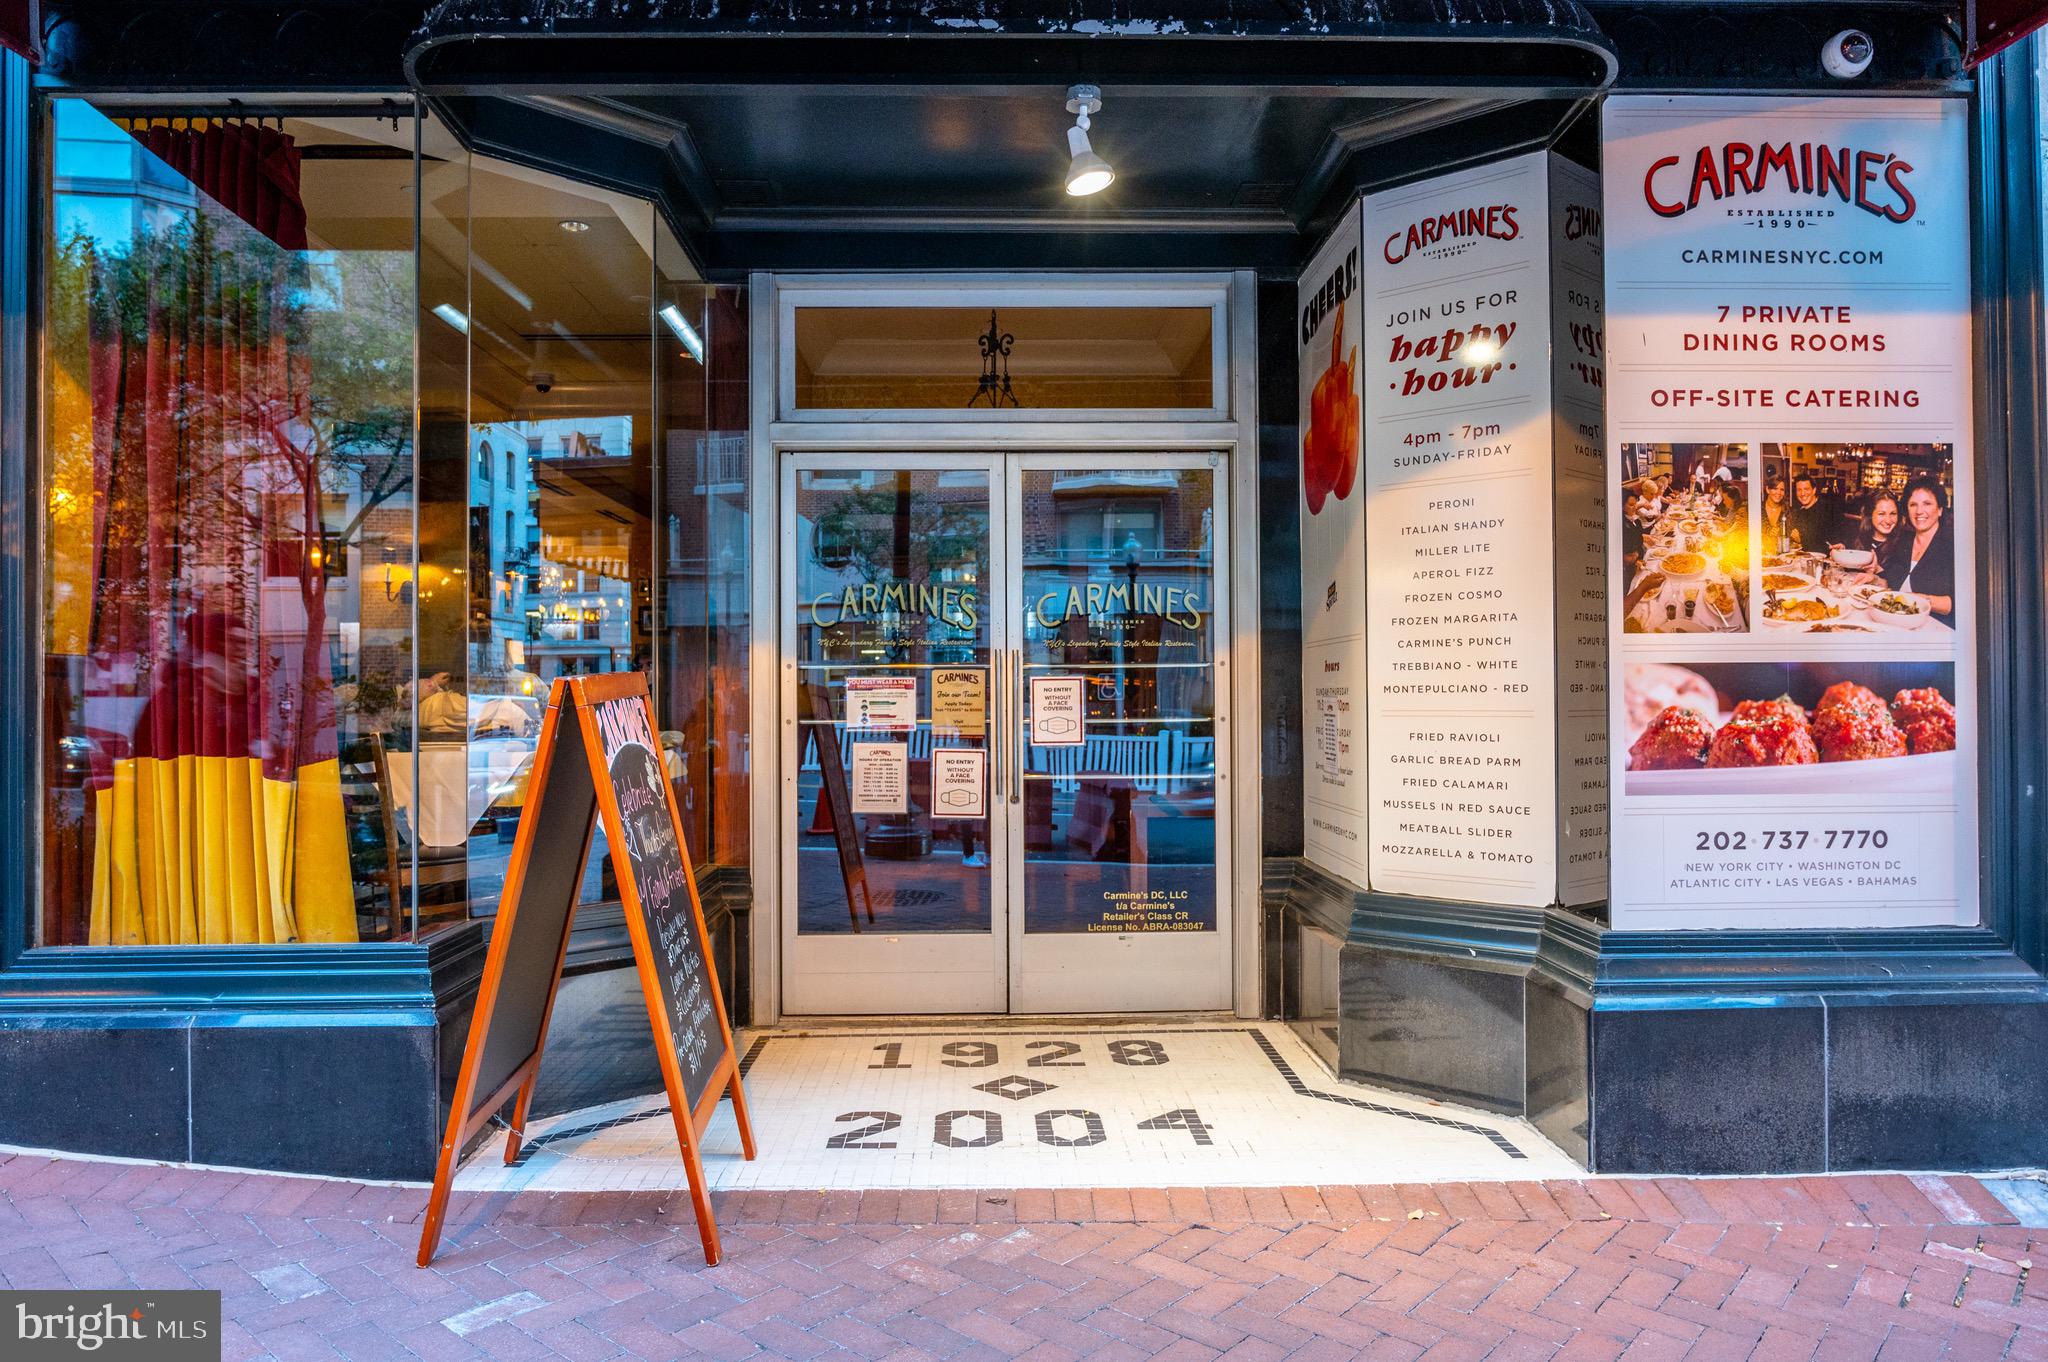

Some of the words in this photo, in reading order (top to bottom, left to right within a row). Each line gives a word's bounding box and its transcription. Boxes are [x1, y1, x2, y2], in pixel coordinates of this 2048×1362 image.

[1644, 142, 1916, 224] CARMINE'S
[1727, 210, 1835, 218] ESTABLISHED
[1384, 204, 1520, 264] CARMINE'S
[1682, 250, 1883, 265] CARMINESNYC.COM
[1302, 246, 1357, 345] CHEERS!
[1386, 307, 1431, 328] JOIN
[1441, 300, 1465, 316] US
[1476, 290, 1517, 310] FOR
[1718, 306, 1730, 323] 7
[1742, 306, 1851, 323] PRIVATE
[1684, 334, 1778, 351] DINING
[1791, 334, 1886, 352] ROOMS
[1650, 389, 1774, 408] OFF-SITE
[1786, 388, 1920, 408] CATERING
[1404, 432, 1440, 447] 4pm
[1462, 424, 1500, 439] 7pm
[1394, 444, 1512, 468] SUNDAY-FRIDAY
[1429, 498, 1474, 510] PERONI
[1402, 523, 1449, 535] ITALIAN
[1454, 519, 1505, 531] SHANDY
[1416, 546, 1458, 557] MILLER
[1464, 544, 1490, 553] LITE
[1413, 569, 1460, 579] APEROL
[1466, 566, 1494, 576] FIZZ
[1405, 593, 1452, 603] FROZEN
[1458, 590, 1503, 600] COSMO
[811, 584, 977, 631] CARMINE'S
[1036, 583, 1201, 630] CARMINE'S
[1391, 616, 1438, 626] FROZEN
[1444, 613, 1518, 624] MARGARITA
[899, 638, 915, 647] Style
[1468, 637, 1511, 646] PUNCH
[1324, 660, 1340, 672] hours
[1392, 661, 1461, 670] TREBBIANO
[1477, 660, 1518, 669] WHITE
[1384, 684, 1488, 693] MONTEPULCIANO
[1503, 684, 1529, 692] RED
[1409, 733, 1444, 742] FRIED
[1450, 734, 1500, 742] RAVIOLI
[1391, 755, 1434, 764] GARLIC
[1440, 757, 1481, 766] BREAD
[1487, 758, 1521, 766] PARM
[1403, 778, 1437, 787] FRIED
[1443, 780, 1508, 790] CALAMARI
[1384, 800, 1436, 810] MUSSELS
[1441, 803, 1453, 811] IN
[1459, 804, 1483, 813] RED
[1488, 805, 1531, 816] SAUCE
[1400, 824, 1462, 835] MEATBALL
[1468, 828, 1512, 838] SLIDER
[1382, 845, 1462, 858] MOZZARELLA
[1468, 851, 1474, 859] &
[1481, 852, 1533, 864] TOMATO
[1686, 862, 1716, 872] NEW
[1719, 862, 1752, 872] YORK
[1756, 862, 1784, 871] CITY
[1798, 861, 1880, 871] WASHINGTON
[1884, 860, 1902, 870] DC
[1670, 878, 1731, 888] ATLANTIC
[1734, 878, 1762, 888] CITY
[1776, 878, 1798, 887] LAS
[1802, 877, 1844, 886] VEGAS
[1857, 876, 1917, 886] BAHAMAS
[1104, 891, 1148, 900] Carmine's
[1151, 891, 1167, 900] DC,
[1170, 891, 1188, 899] LLC
[1130, 902, 1175, 910] Carmine's
[1148, 912, 1172, 920] Class
[1088, 923, 1122, 931] License
[1142, 922, 1204, 931] ABRA-083047
[867, 1039, 1169, 1069] 1928
[826, 1109, 1214, 1150] 2004
